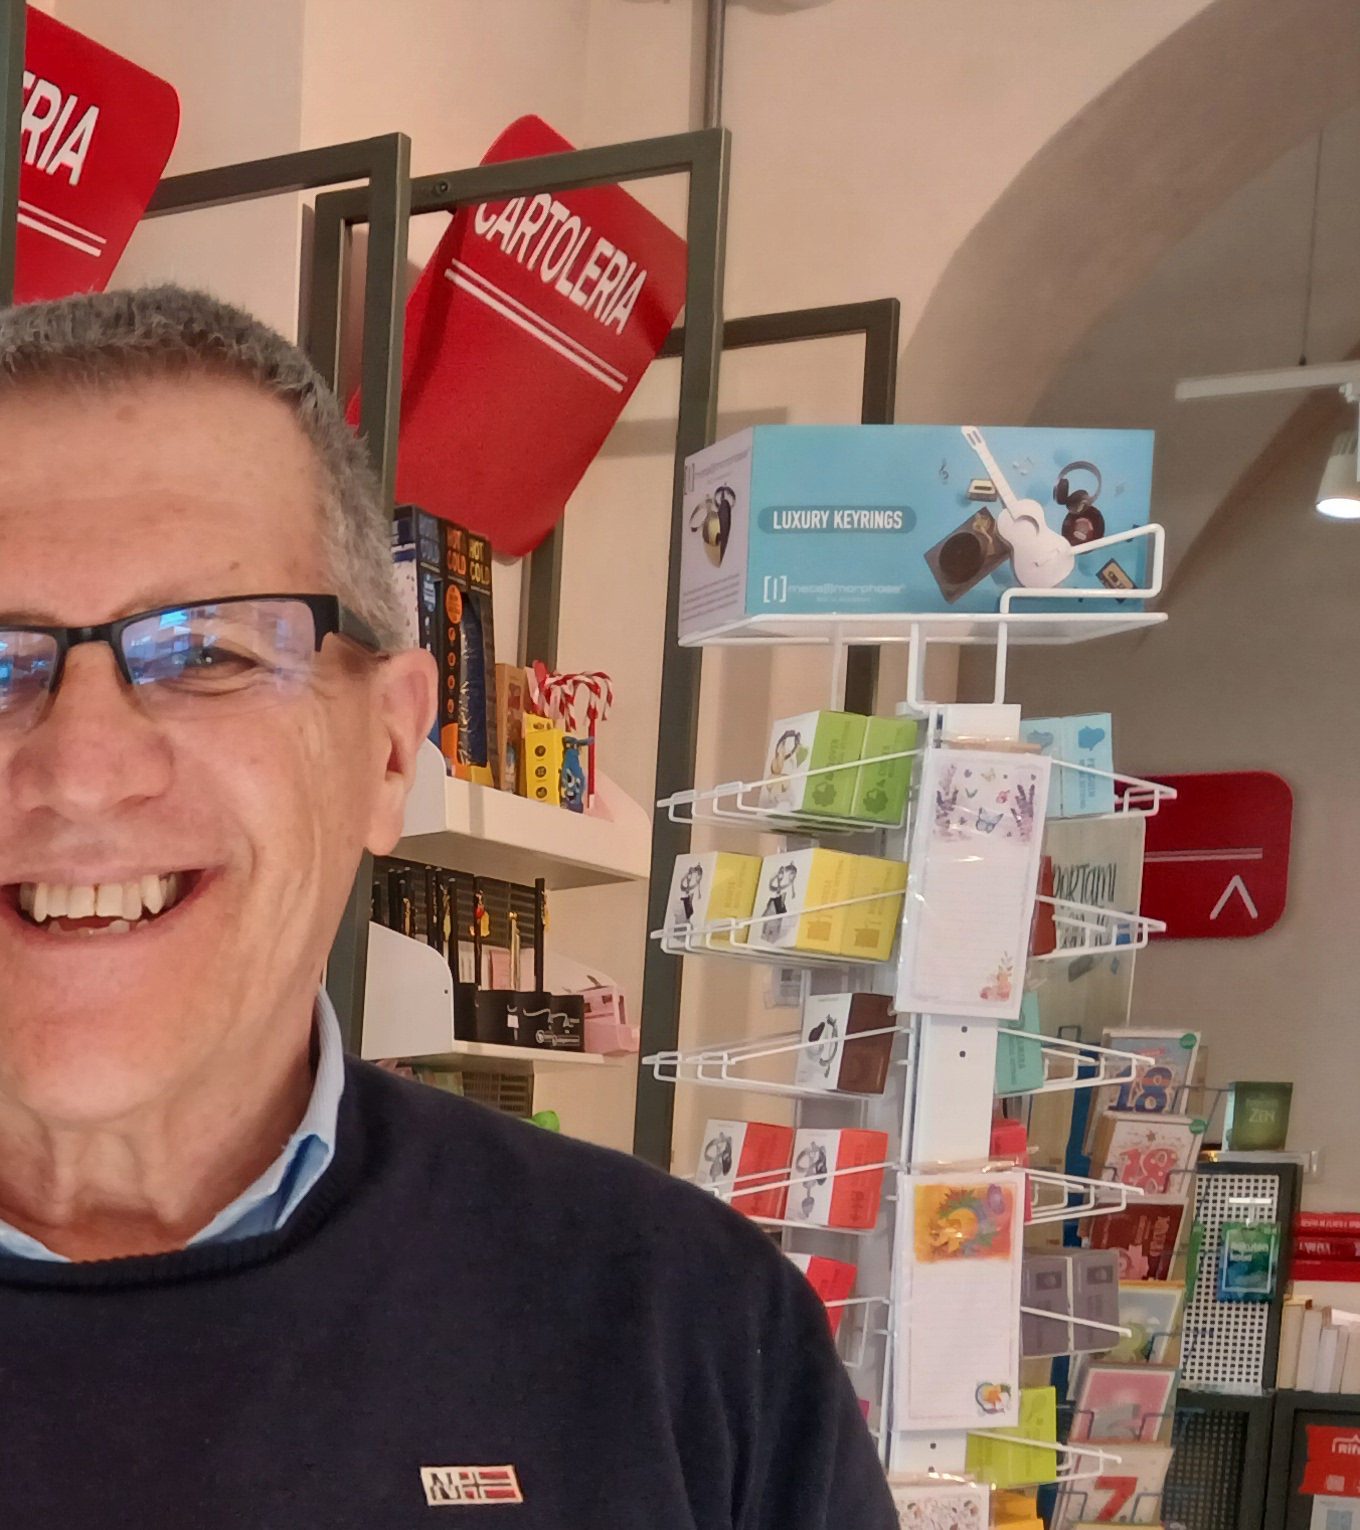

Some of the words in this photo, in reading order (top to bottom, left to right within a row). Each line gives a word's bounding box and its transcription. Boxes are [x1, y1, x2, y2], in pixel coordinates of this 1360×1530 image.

[474, 193, 647, 335] CARTOLERIA
[772, 510, 828, 530] LUXURY
[833, 510, 903, 530] KEYRINGS
[1093, 1477, 1137, 1522] 7
